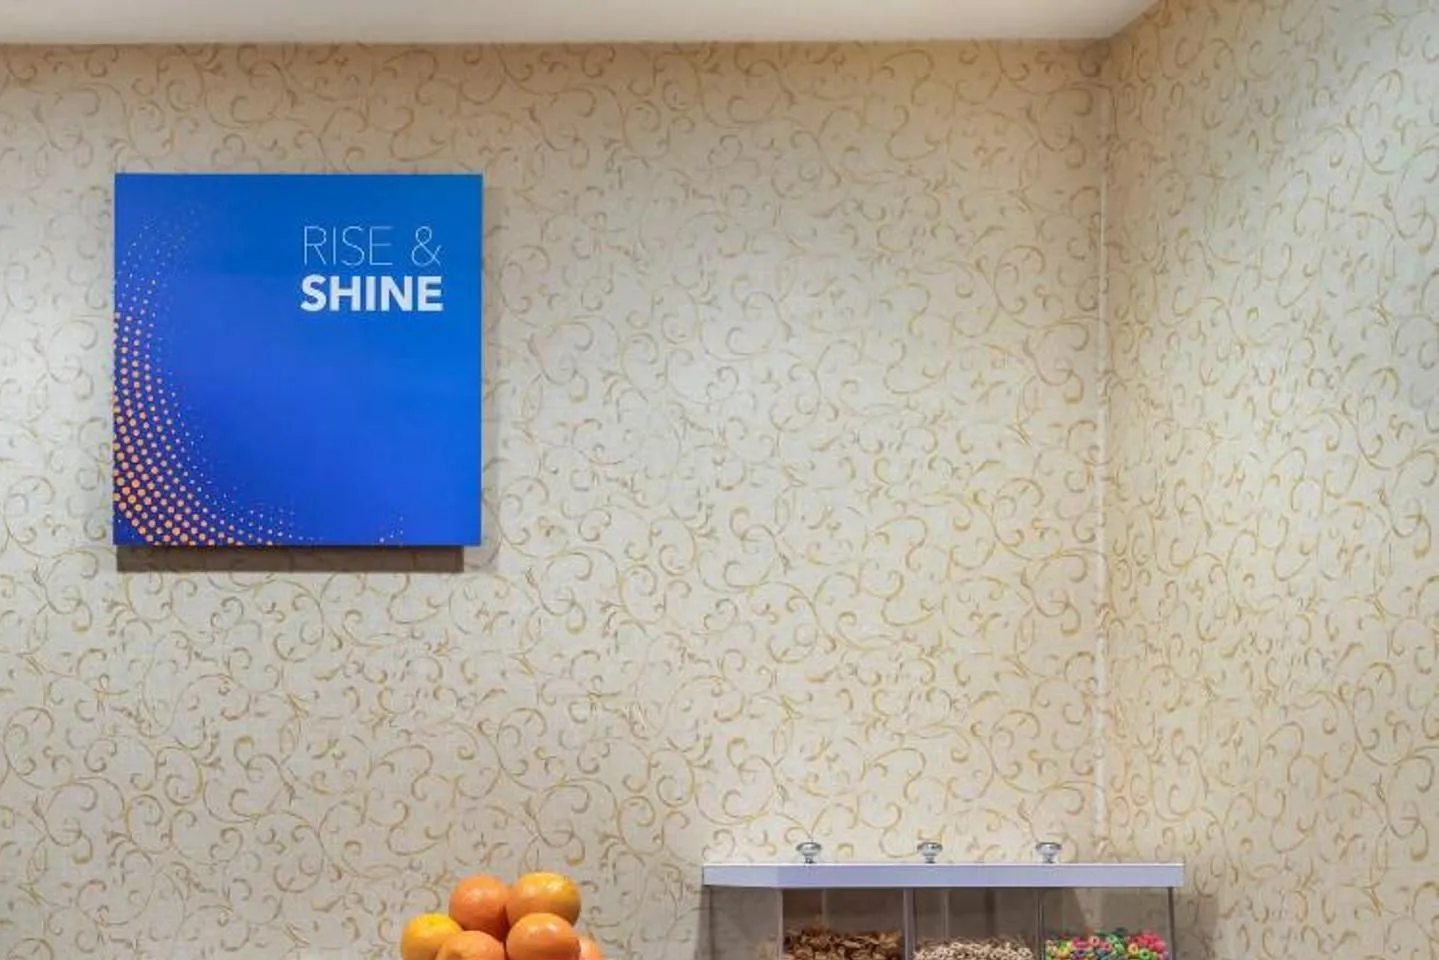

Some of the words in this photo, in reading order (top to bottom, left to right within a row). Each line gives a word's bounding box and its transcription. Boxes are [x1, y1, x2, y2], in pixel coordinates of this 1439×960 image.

[303, 225, 394, 266] RISE
[411, 225, 443, 267] &
[300, 273, 445, 312] SHINE
